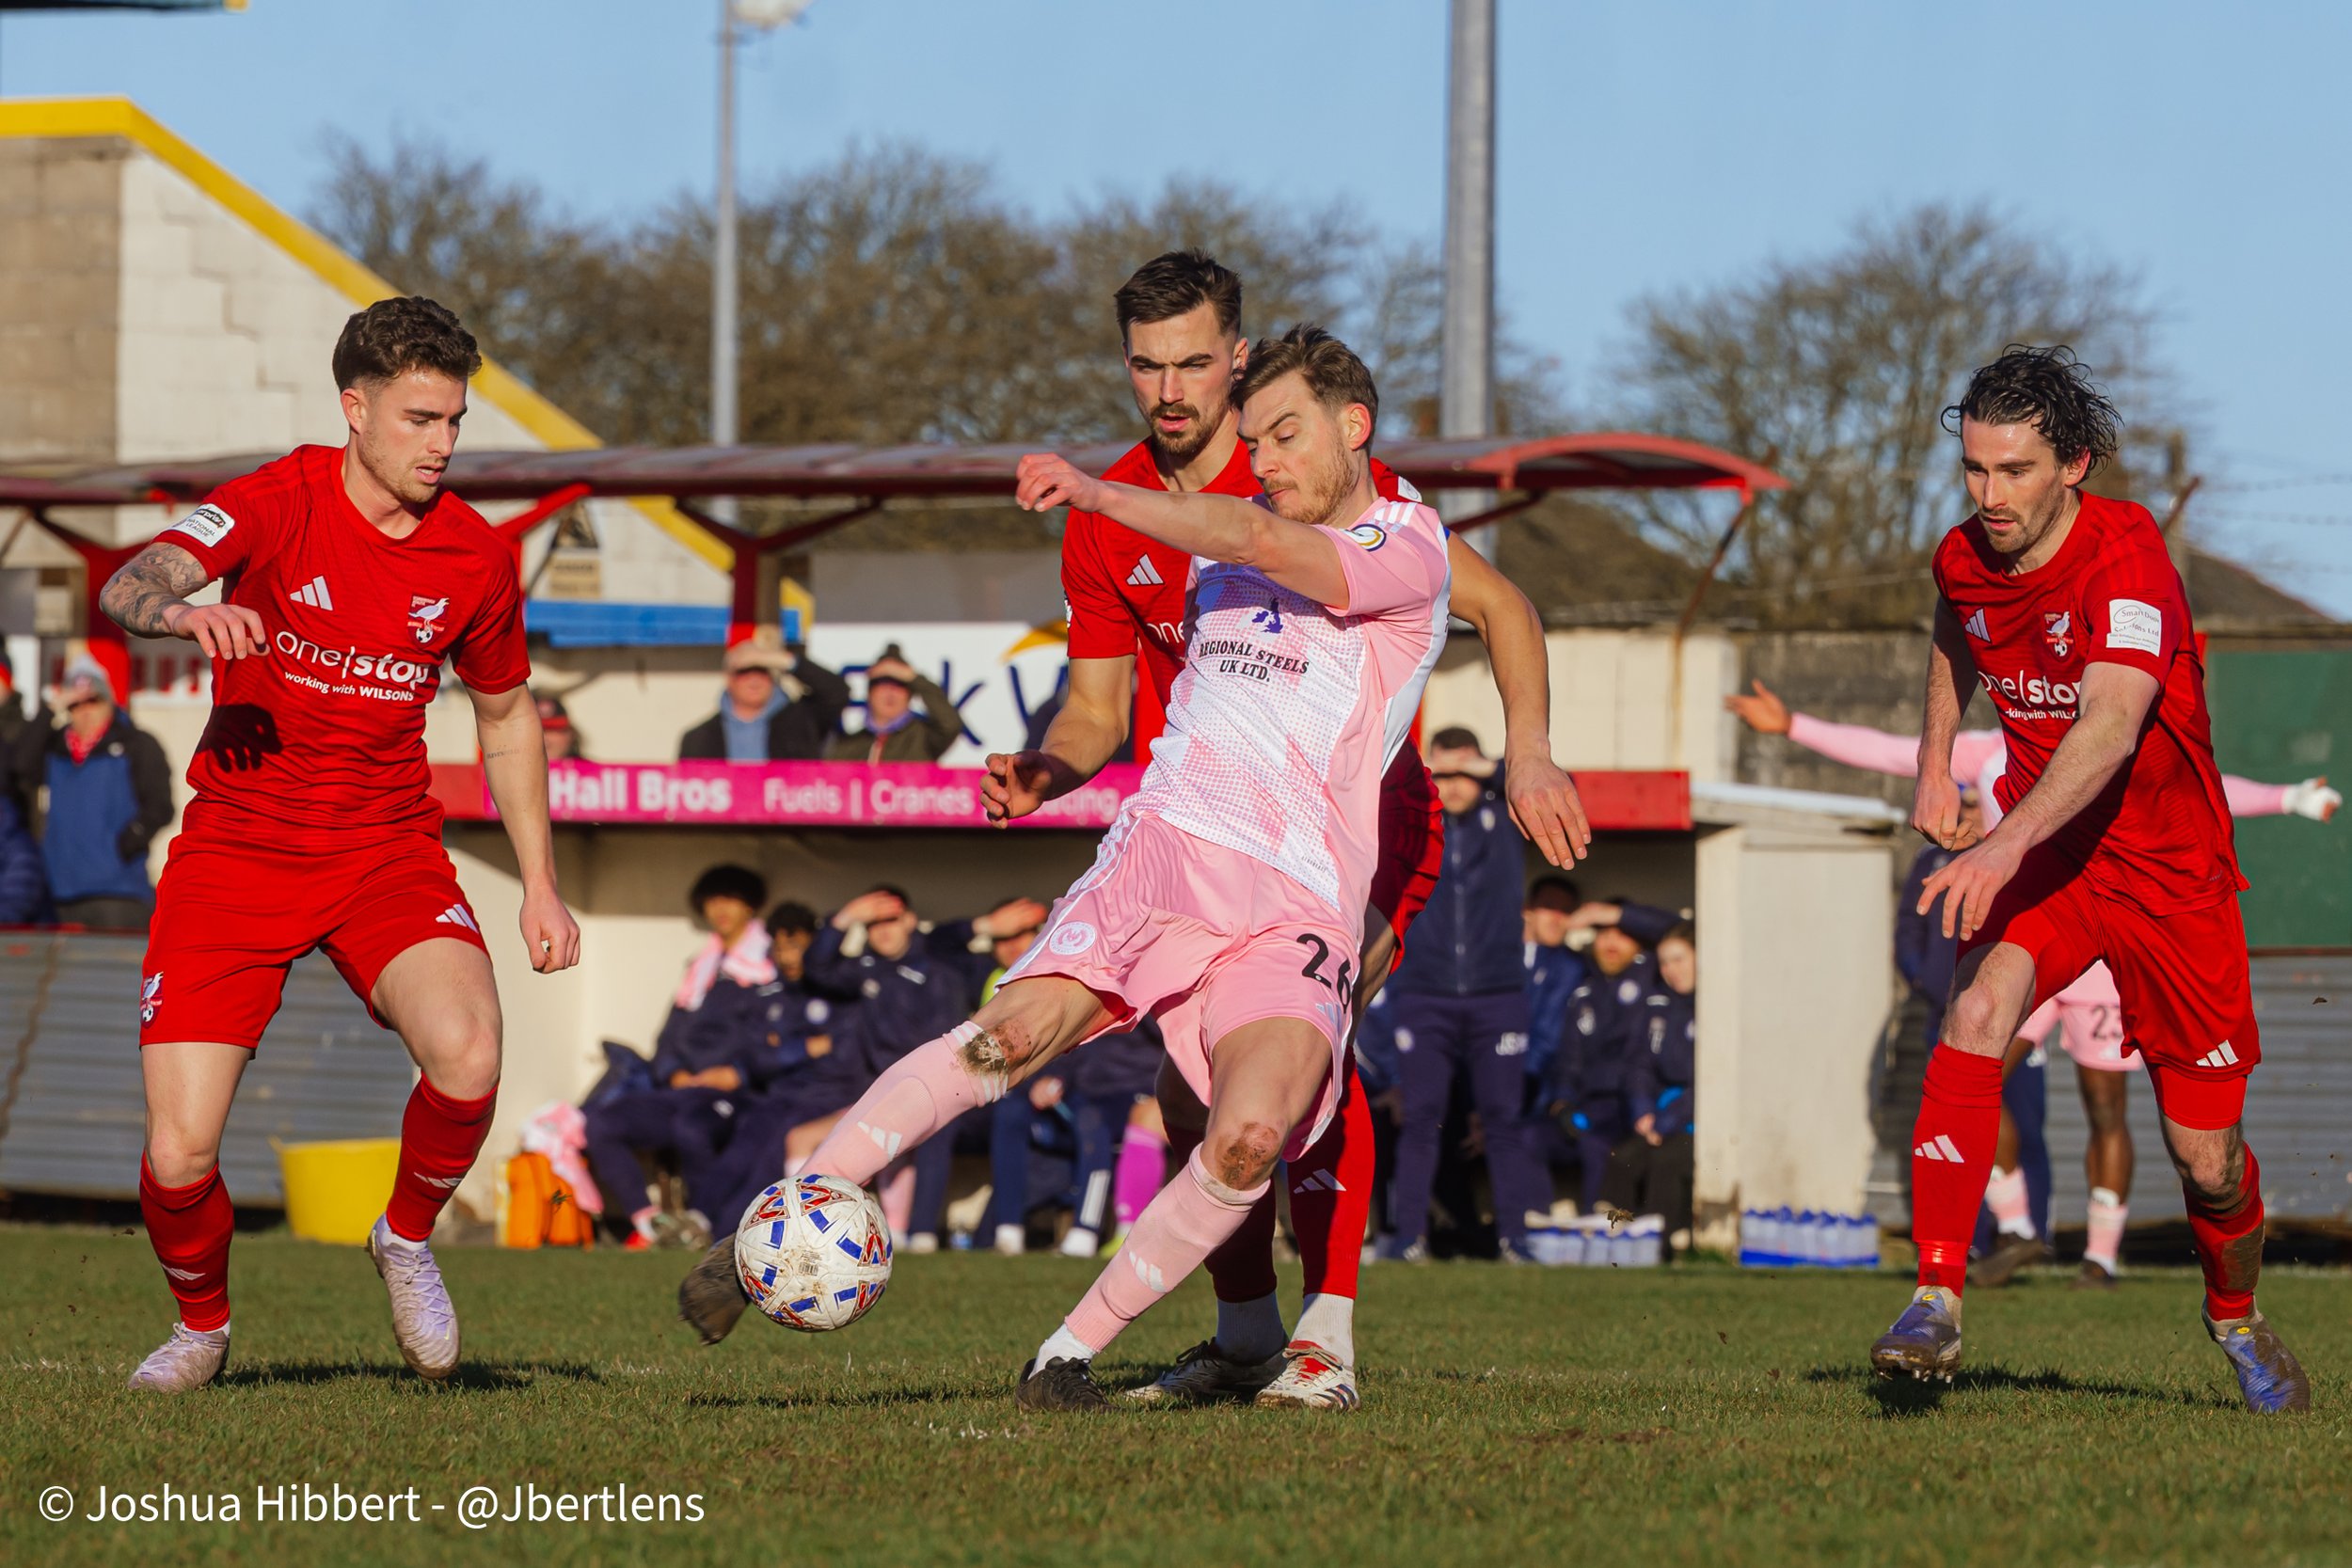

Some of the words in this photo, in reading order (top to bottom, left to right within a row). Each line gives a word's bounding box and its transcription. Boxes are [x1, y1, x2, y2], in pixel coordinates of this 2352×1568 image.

[1200, 641, 1252, 657] REGIONAL
[1256, 650, 1310, 674] STEELS
[1220, 660, 1236, 673] UK
[1241, 663, 1270, 683] LTD.
[284, 672, 329, 694] working
[332, 684, 356, 694] with
[359, 686, 414, 702] WILSONS
[2028, 709, 2046, 720] with
[550, 768, 628, 811] Hall
[638, 769, 733, 815] Bros
[763, 779, 843, 815] Fuels
[869, 780, 974, 816] Cranes
[1296, 933, 1352, 1015] 26
